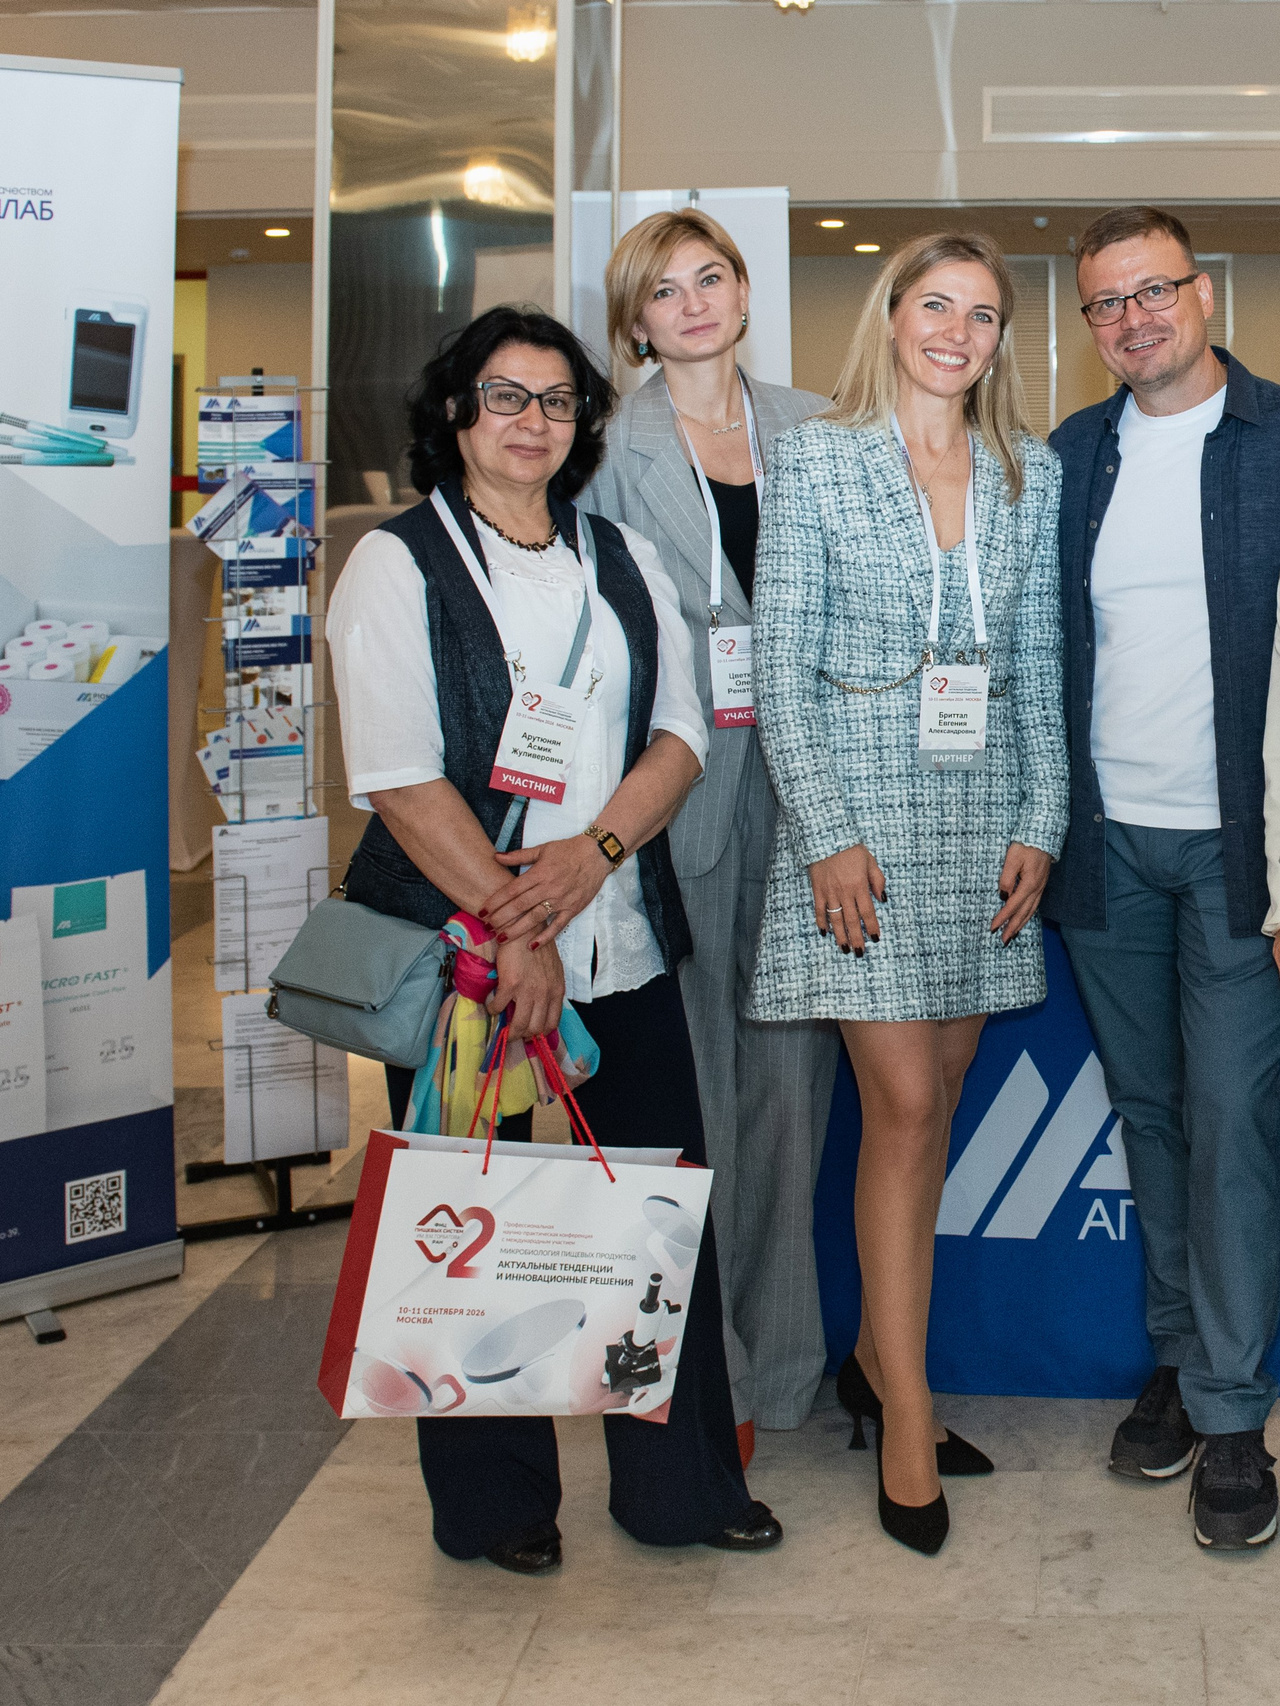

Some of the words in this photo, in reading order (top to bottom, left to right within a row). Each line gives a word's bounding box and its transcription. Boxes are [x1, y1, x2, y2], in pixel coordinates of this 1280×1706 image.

[0, 199, 53, 220] ЛАБ
[939, 711, 968, 720] Бриттал
[522, 732, 561, 746] Арутюнян
[527, 742, 552, 754] Асмик
[932, 754, 974, 762] ПАРТНЕР
[502, 773, 556, 795] УЧАСТНИК
[83, 968, 119, 984] FAST
[504, 1221, 554, 1230] Профессиональная
[500, 1248, 559, 1256] МИКРОБИОЛОГИЯ
[498, 1260, 558, 1271] АКТУАЛЬНЫЕ
[560, 1263, 613, 1273] ТЕНДЕНЦИИ
[496, 1272, 503, 1280] И
[505, 1273, 588, 1284] ИННОВАЦИОННЫЕ
[590, 1277, 634, 1286] РЕШЕНИЯ
[396, 1316, 433, 1324] МОСКВА
